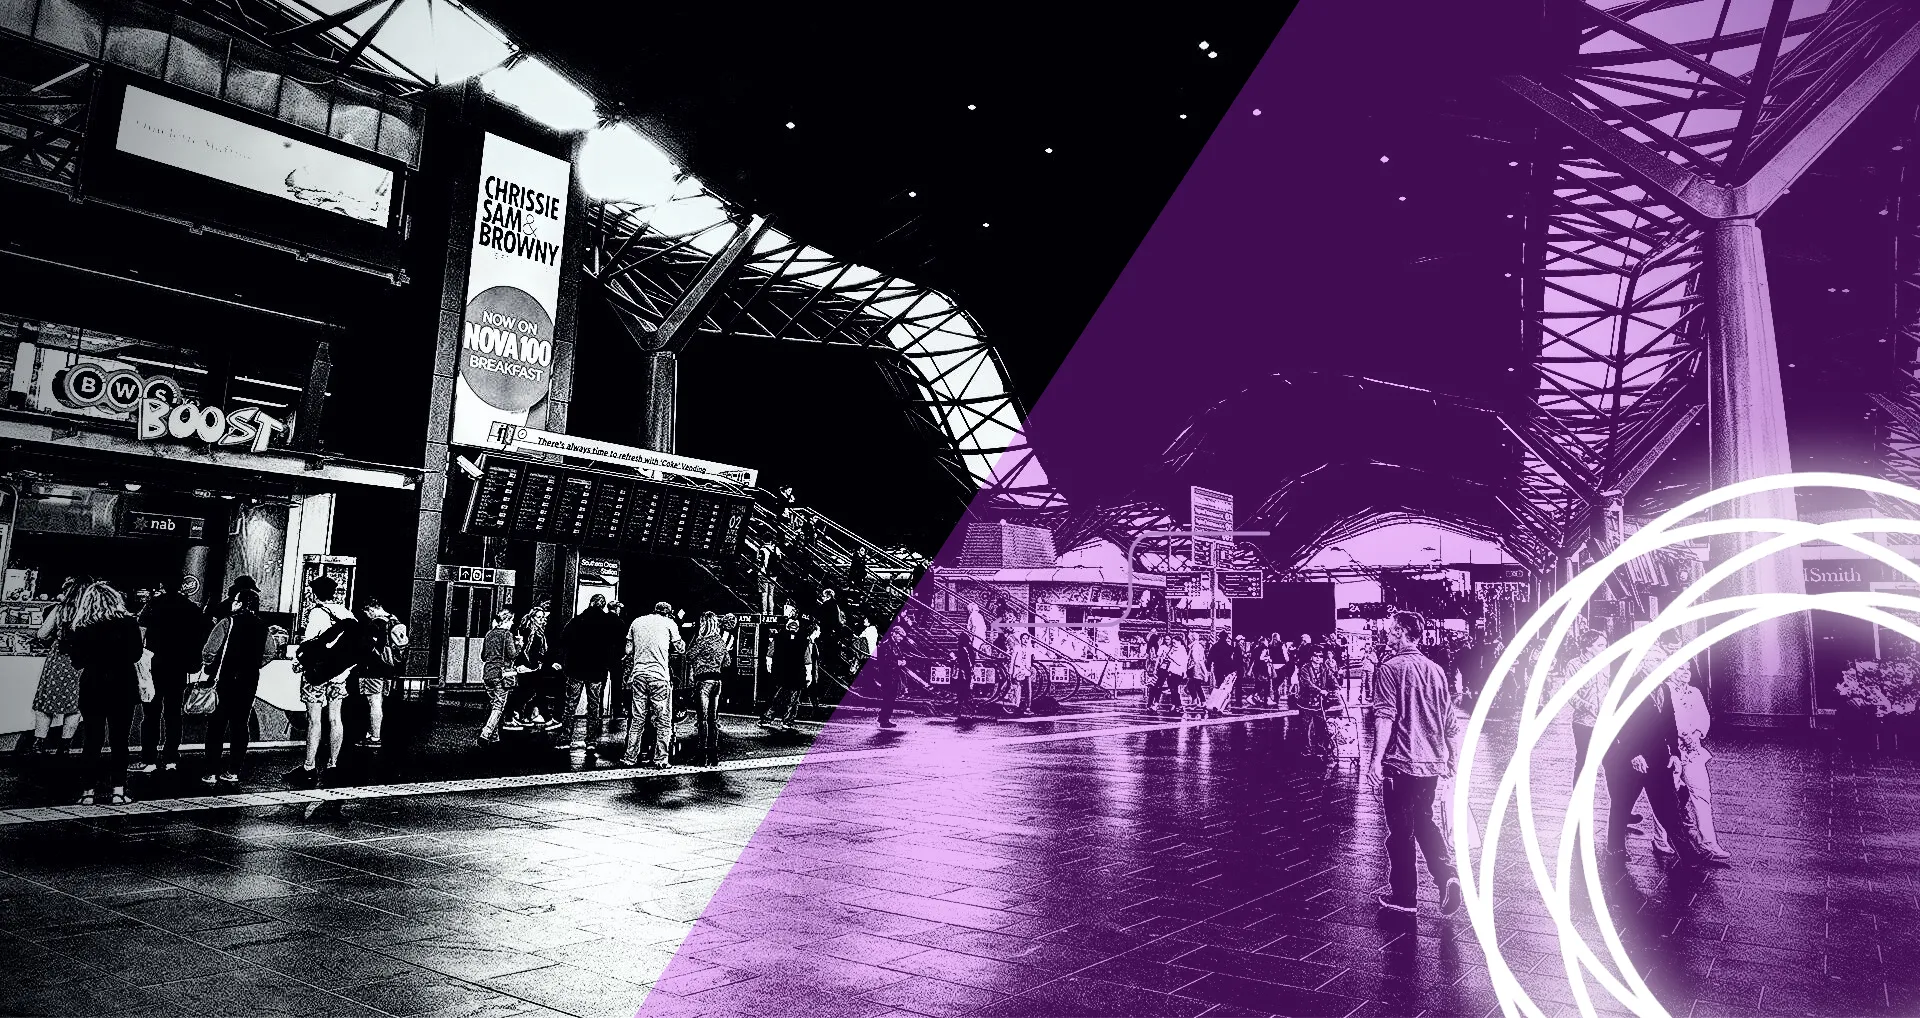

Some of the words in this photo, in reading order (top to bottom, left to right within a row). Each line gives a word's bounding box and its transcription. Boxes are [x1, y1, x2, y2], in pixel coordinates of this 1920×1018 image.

[485, 176, 559, 220] CHRISSIE
[479, 222, 559, 266] BROWNY
[483, 311, 516, 329] NOW
[518, 320, 538, 336] ON
[463, 321, 519, 360] NOVA
[520, 336, 551, 367] 100
[470, 354, 544, 381] BREAKFAST
[138, 397, 284, 452] BOOST
[538, 437, 565, 449] There's
[566, 443, 590, 454] always
[592, 447, 608, 456] time
[619, 453, 642, 462] refresh
[644, 457, 658, 465] with
[681, 463, 706, 474] Vending
[151, 519, 175, 530] nab
[729, 515, 741, 529] 02
[1349, 604, 1361, 612] 2A
